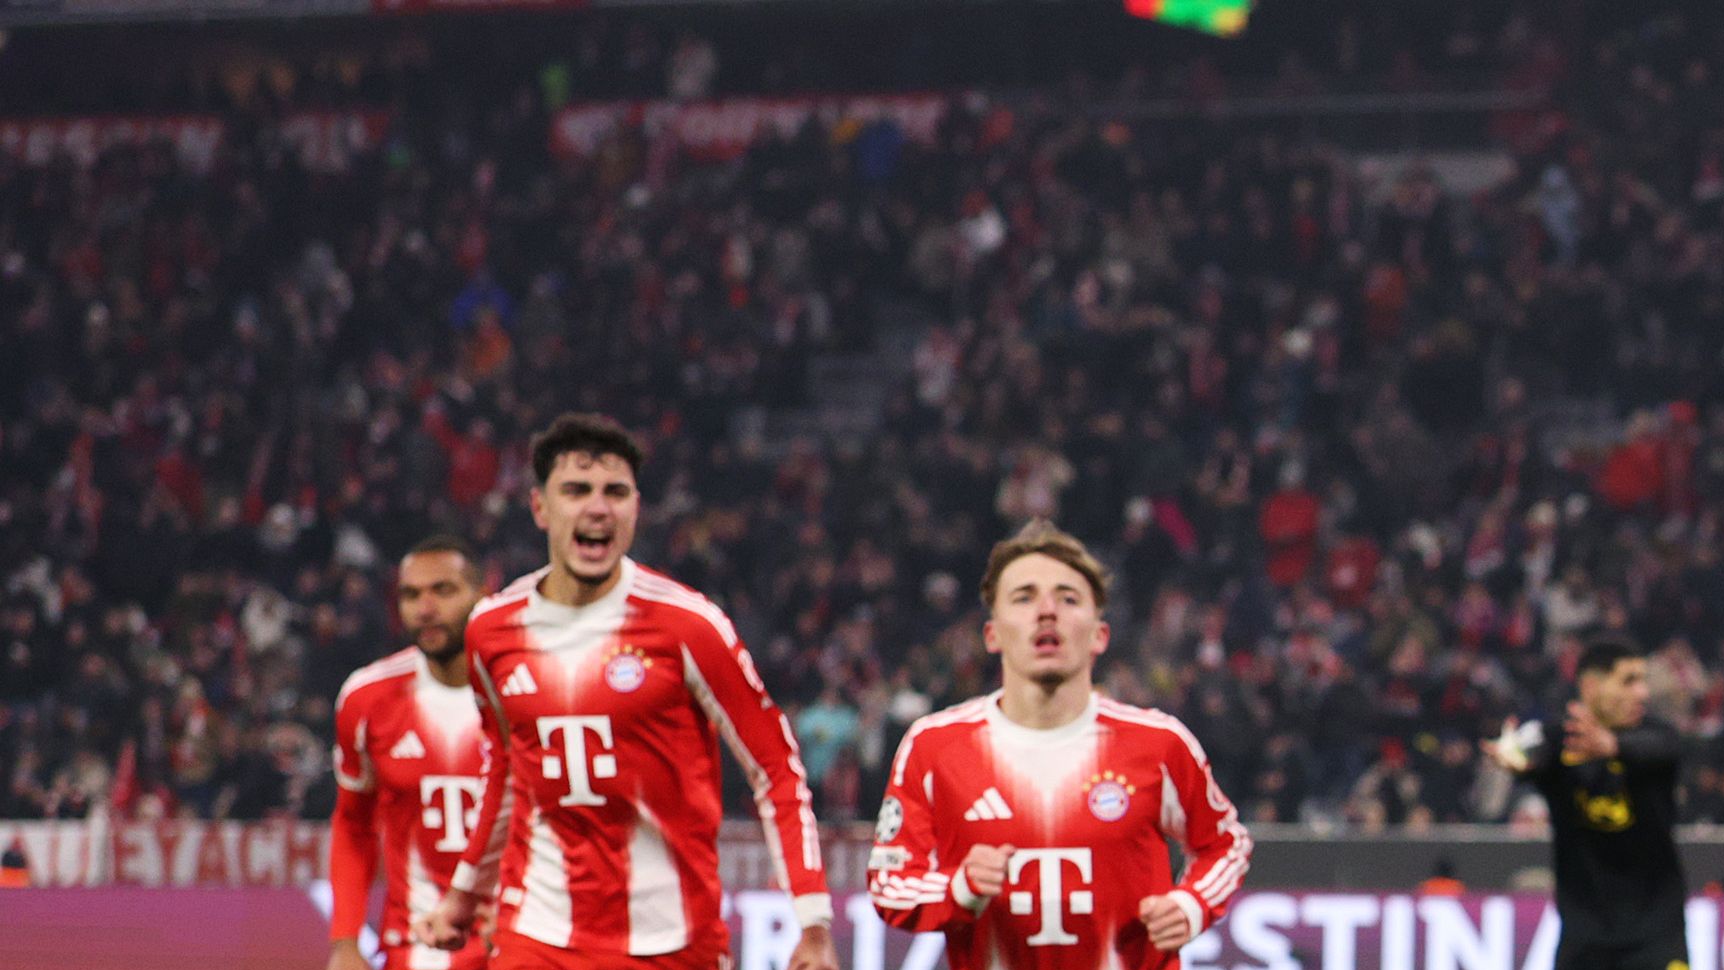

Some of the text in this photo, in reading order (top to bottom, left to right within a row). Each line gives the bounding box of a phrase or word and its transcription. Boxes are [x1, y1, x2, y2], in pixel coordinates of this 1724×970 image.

[536, 715, 617, 807] T
[419, 774, 485, 852] T
[1008, 847, 1093, 947] T
